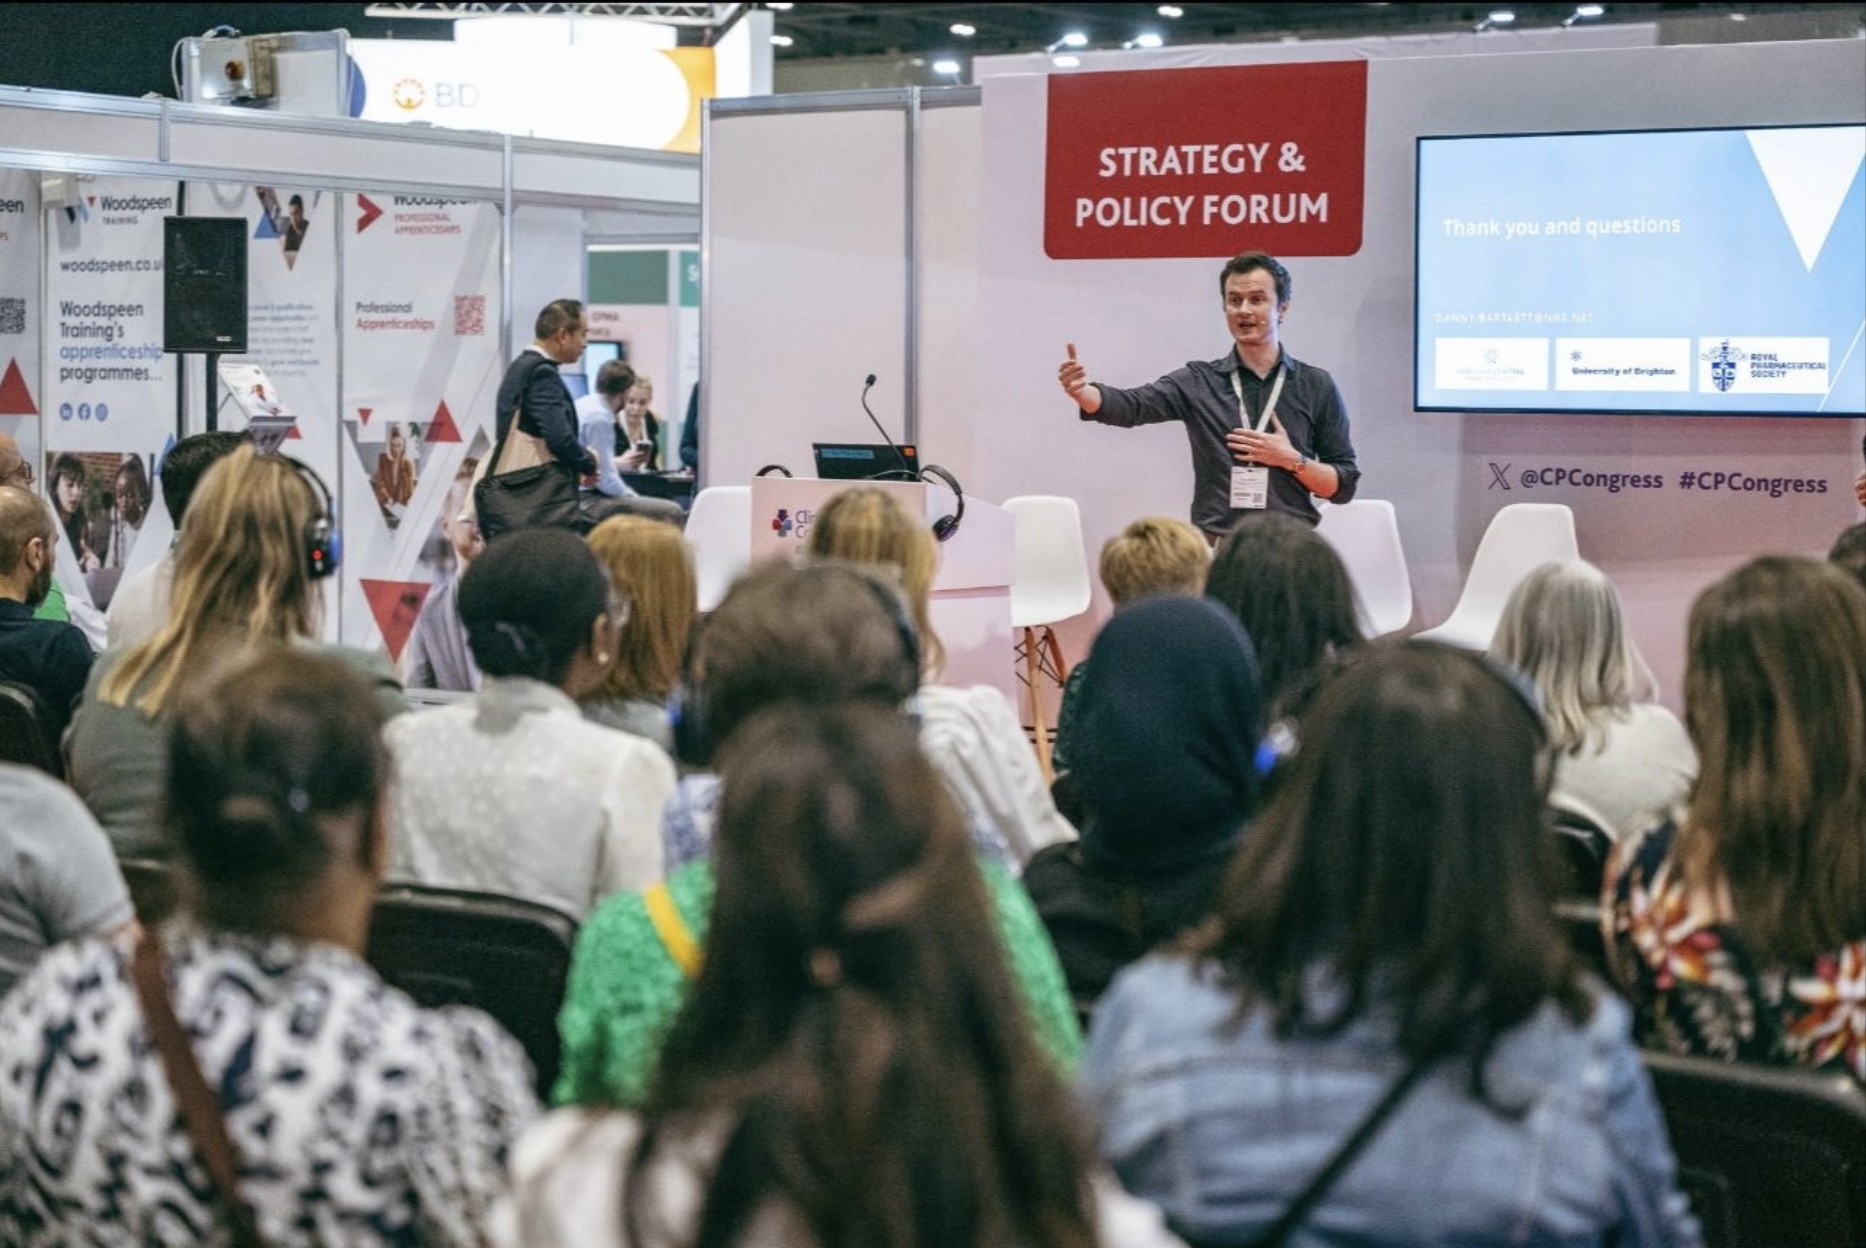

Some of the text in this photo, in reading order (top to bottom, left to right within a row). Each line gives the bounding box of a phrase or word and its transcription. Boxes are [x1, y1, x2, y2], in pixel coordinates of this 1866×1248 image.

[435, 82, 480, 108] BD
[1099, 142, 1306, 178] STRATEGY &
[101, 195, 172, 214] Woodspeen
[1075, 192, 1328, 228] POLICY FORUM
[102, 217, 139, 225] TRAINING
[1443, 215, 1682, 240] Thank you and questions
[60, 258, 164, 273] woodspeen.co.u
[60, 300, 144, 320] Woodspeen
[356, 301, 413, 313] Professional
[60, 321, 125, 342] Training's
[356, 318, 435, 331] Apprenticeships
[60, 343, 164, 362] apprenticeship
[1750, 353, 1778, 361] ROYAL
[1571, 367, 1676, 377] University of Brighton
[1750, 362, 1826, 370] PHARMACEUTICAL
[1750, 370, 1787, 378] SOCIETY
[1520, 467, 1664, 492] @CPCongress
[1679, 471, 1828, 494] #CPCongress
